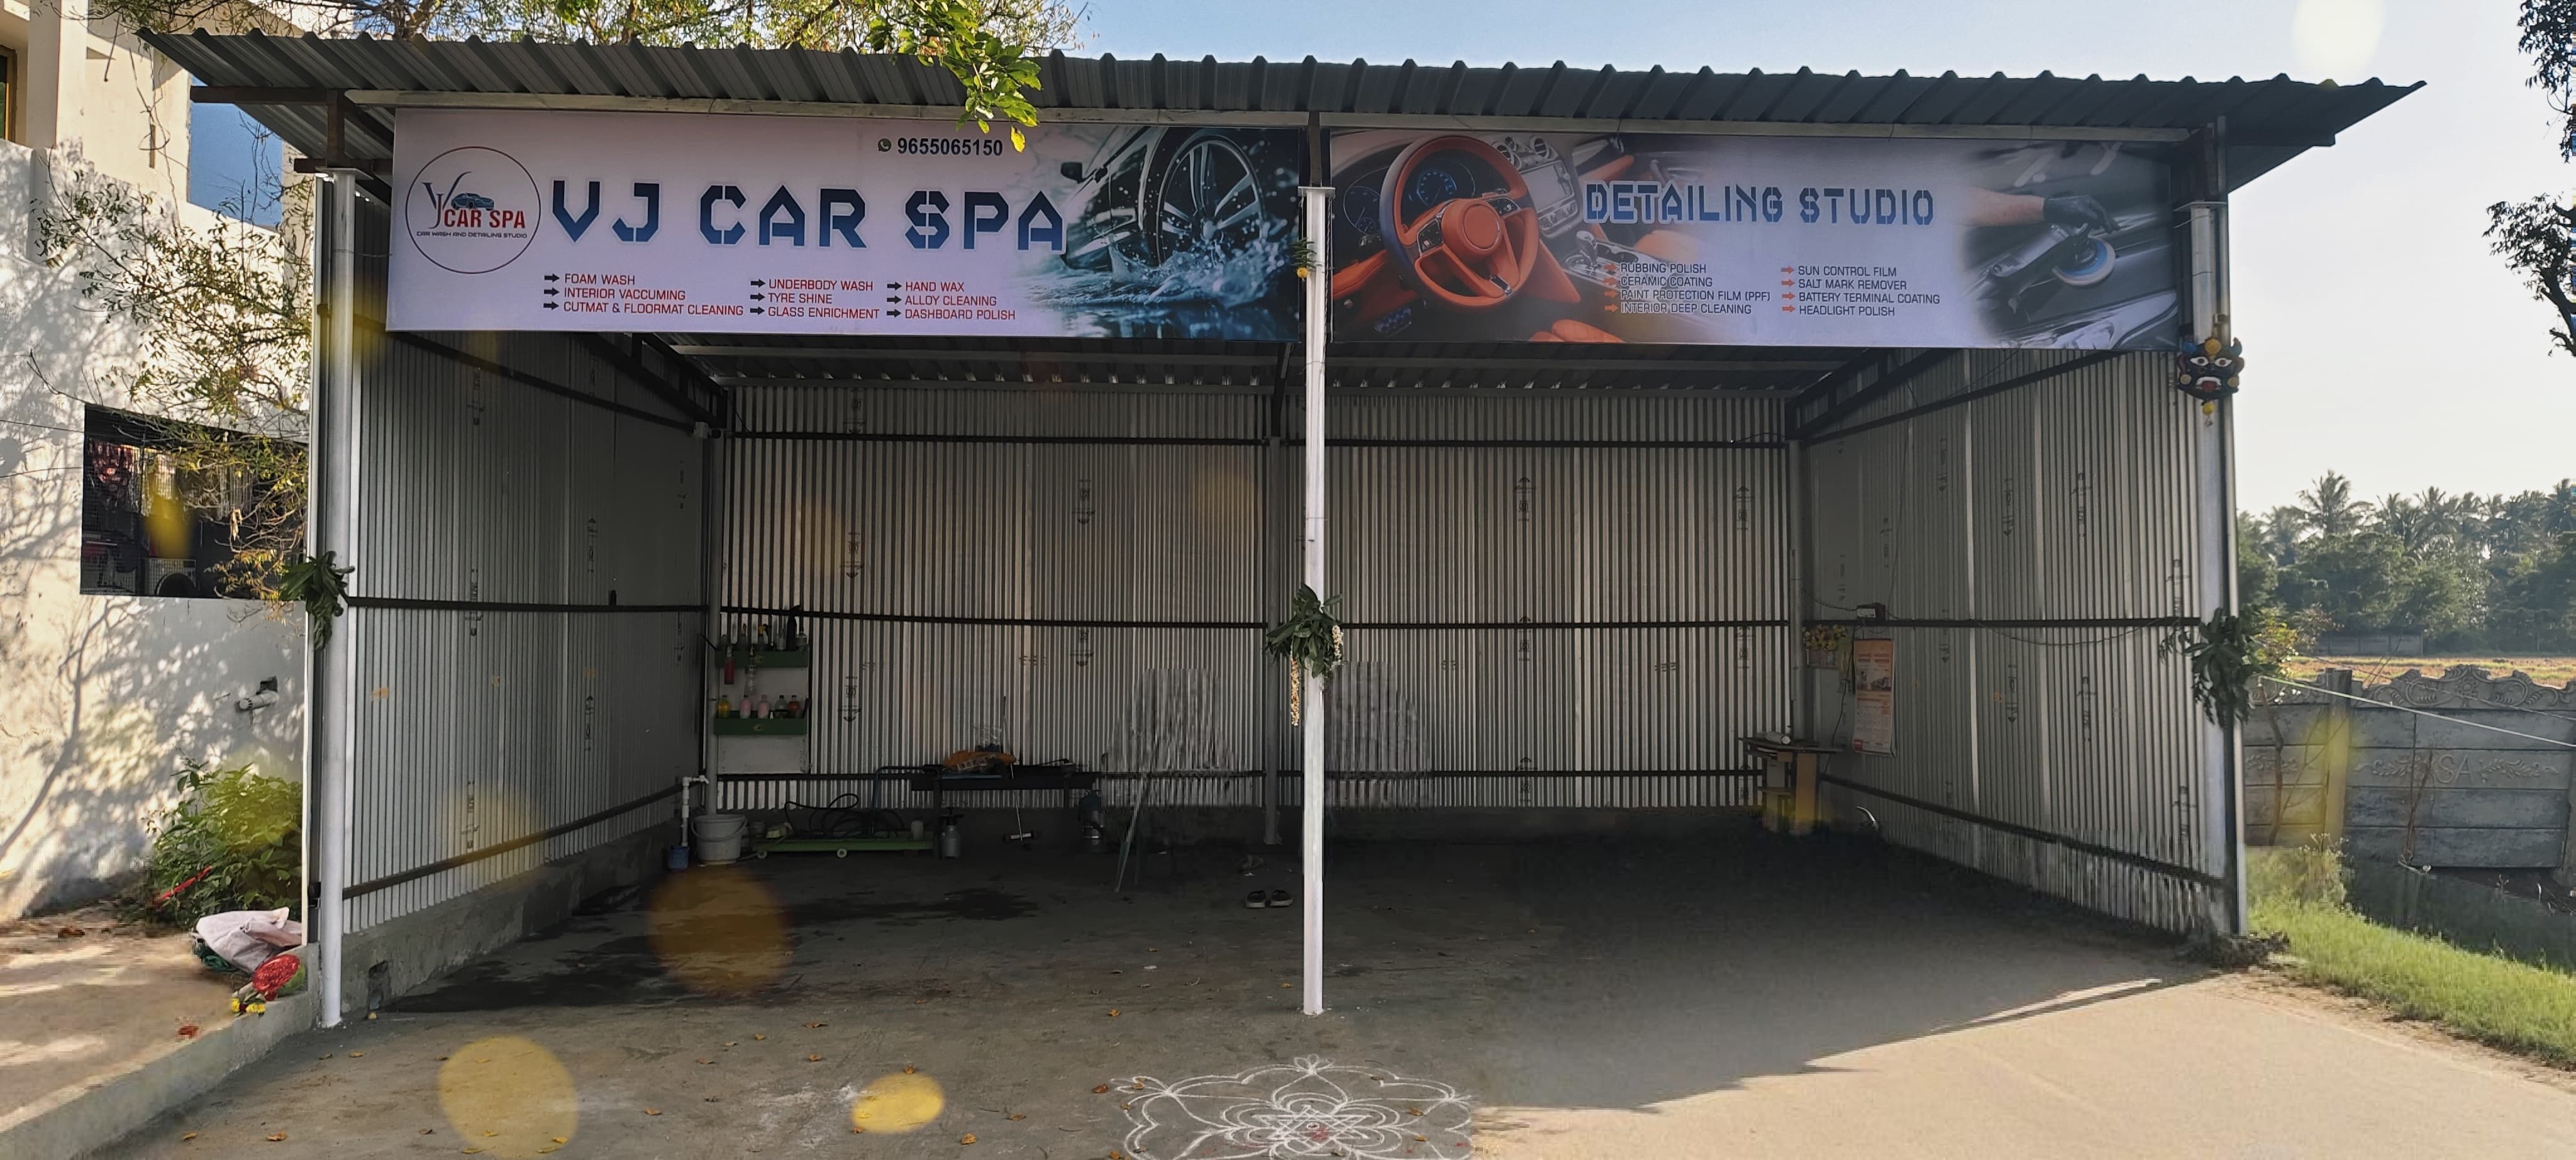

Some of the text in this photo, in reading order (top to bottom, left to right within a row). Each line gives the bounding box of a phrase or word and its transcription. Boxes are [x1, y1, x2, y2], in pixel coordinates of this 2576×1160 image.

[897, 138, 1003, 156] 9655065150
[1587, 183, 1933, 225] DETAILING STUDIO
[444, 209, 525, 228] CAR SPA
[552, 180, 1063, 251] VJ CAR SPA
[1621, 263, 1706, 274] RUBBING POLISH
[1798, 265, 1897, 277] SUN CONTROL FILM
[565, 273, 635, 286] FOAM WASH
[769, 279, 873, 291] UNDERBODY WASH
[1621, 277, 1713, 287] CERAMIC COATING
[1798, 279, 1907, 290] SALT MARK REMOVER
[905, 282, 965, 292] HAND WAX
[564, 287, 686, 301] INTERIOR VACCUMING
[768, 293, 832, 304] TYRE SHINE
[1621, 290, 1770, 301] PAINT PROTECTION FILM (PPF)
[1799, 292, 1940, 304] BATTERY TERMINAL COATING
[905, 296, 997, 306] ALLOY CLEANING
[564, 301, 743, 315] CUTMAT & FLOORMAT CLEANING
[768, 306, 879, 319] GLASS ENRICHMENT
[1621, 303, 1752, 314] INTERIOR DEEP CLEANING
[1799, 305, 1895, 316] HEADLIGHT POLISH
[905, 309, 1015, 320] DASHBOARD POLISH
